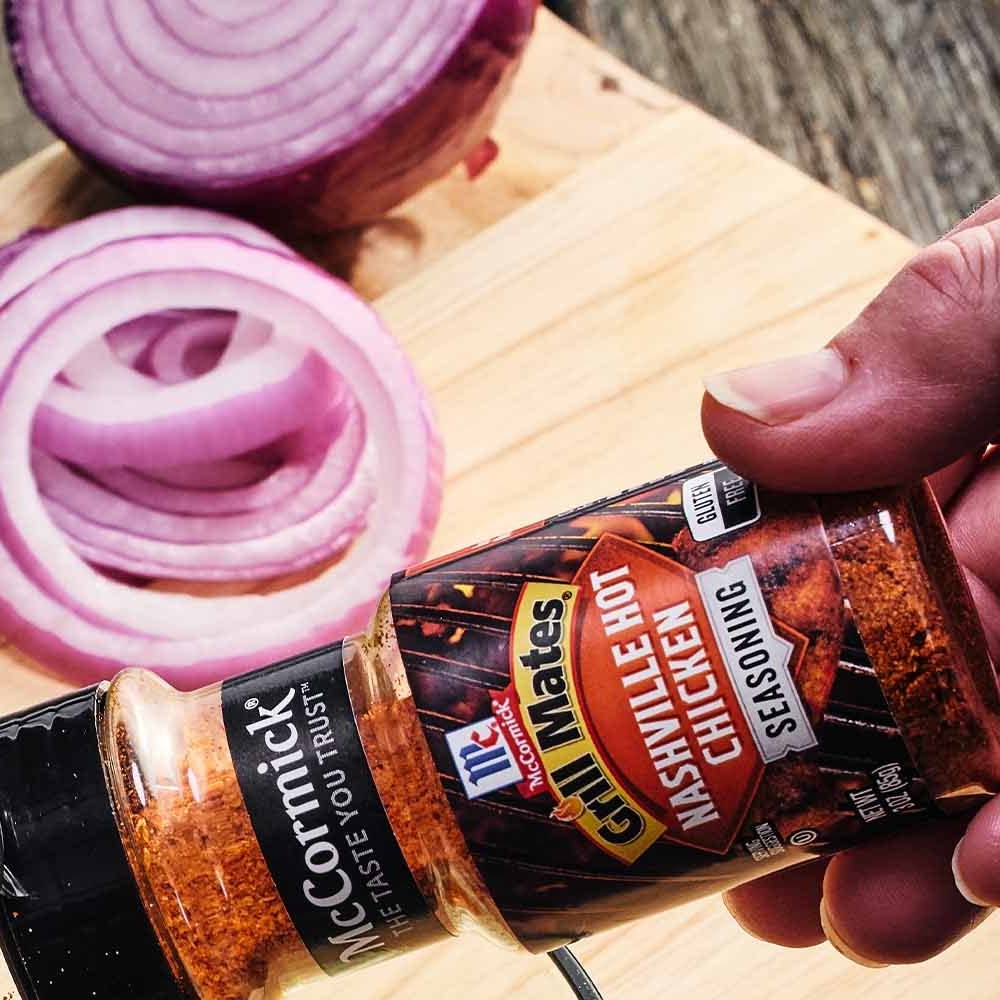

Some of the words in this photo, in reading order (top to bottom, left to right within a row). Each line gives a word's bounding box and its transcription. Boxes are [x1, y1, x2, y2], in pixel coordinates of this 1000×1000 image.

[690, 481, 718, 525] GLUTEN
[722, 478, 748, 507] FREE
[589, 564, 645, 637] HOT
[652, 600, 743, 766] CHICKEN
[715, 579, 798, 739] SEASONING
[610, 632, 721, 832] NASHVILLE
[322, 768, 360, 827] YOU
[549, 751, 647, 846] Grill
[849, 788, 877, 810] WT
[858, 803, 887, 823] NET
[345, 828, 394, 904] TASTE
[379, 902, 414, 938] THE
